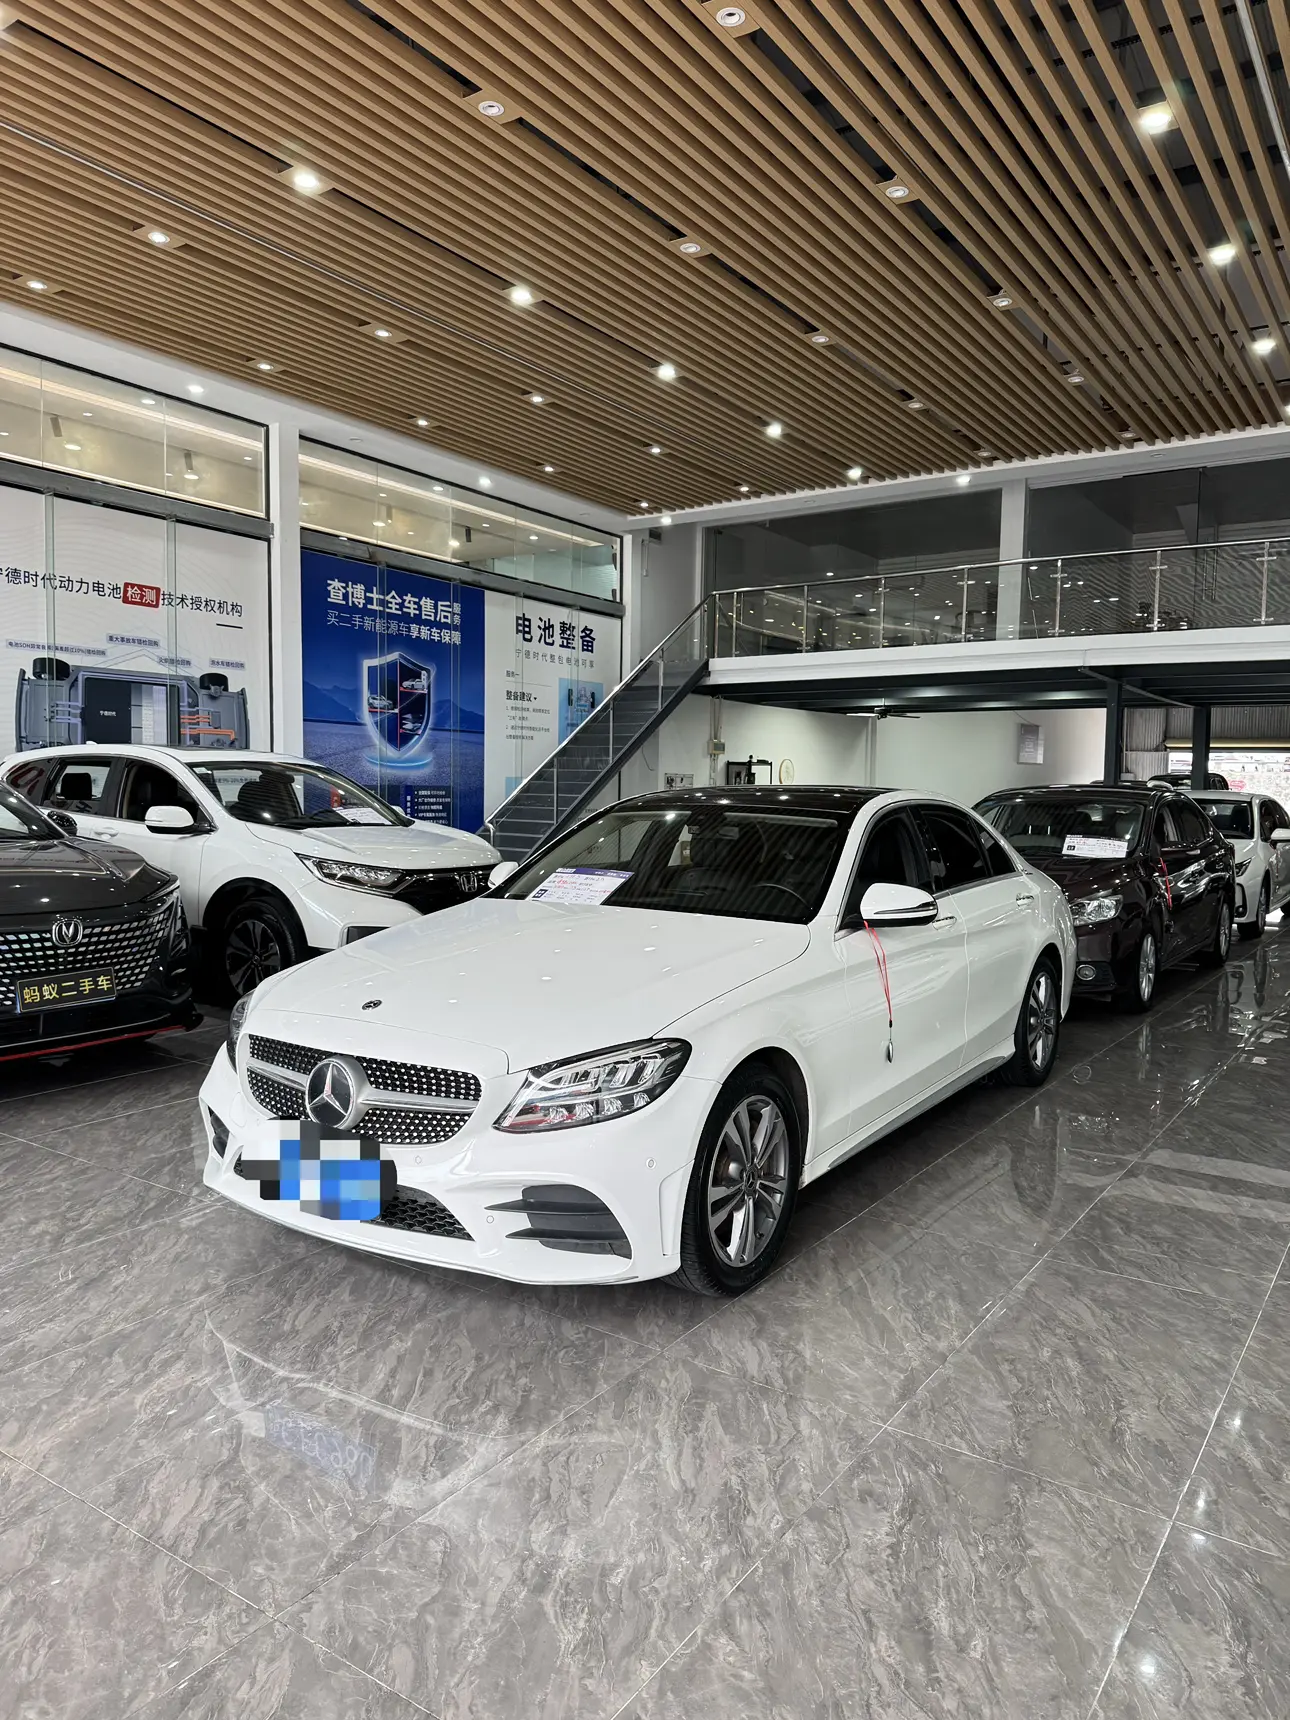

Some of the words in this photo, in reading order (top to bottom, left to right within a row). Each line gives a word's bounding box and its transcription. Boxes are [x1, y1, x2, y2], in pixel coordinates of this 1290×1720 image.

[327, 579, 452, 624] 查博士全车售后
[327, 609, 462, 646] 买二手新能源车享新车保障
[515, 613, 596, 653] 电池整备
[23, 975, 113, 1004] 蚂蚁二手车
